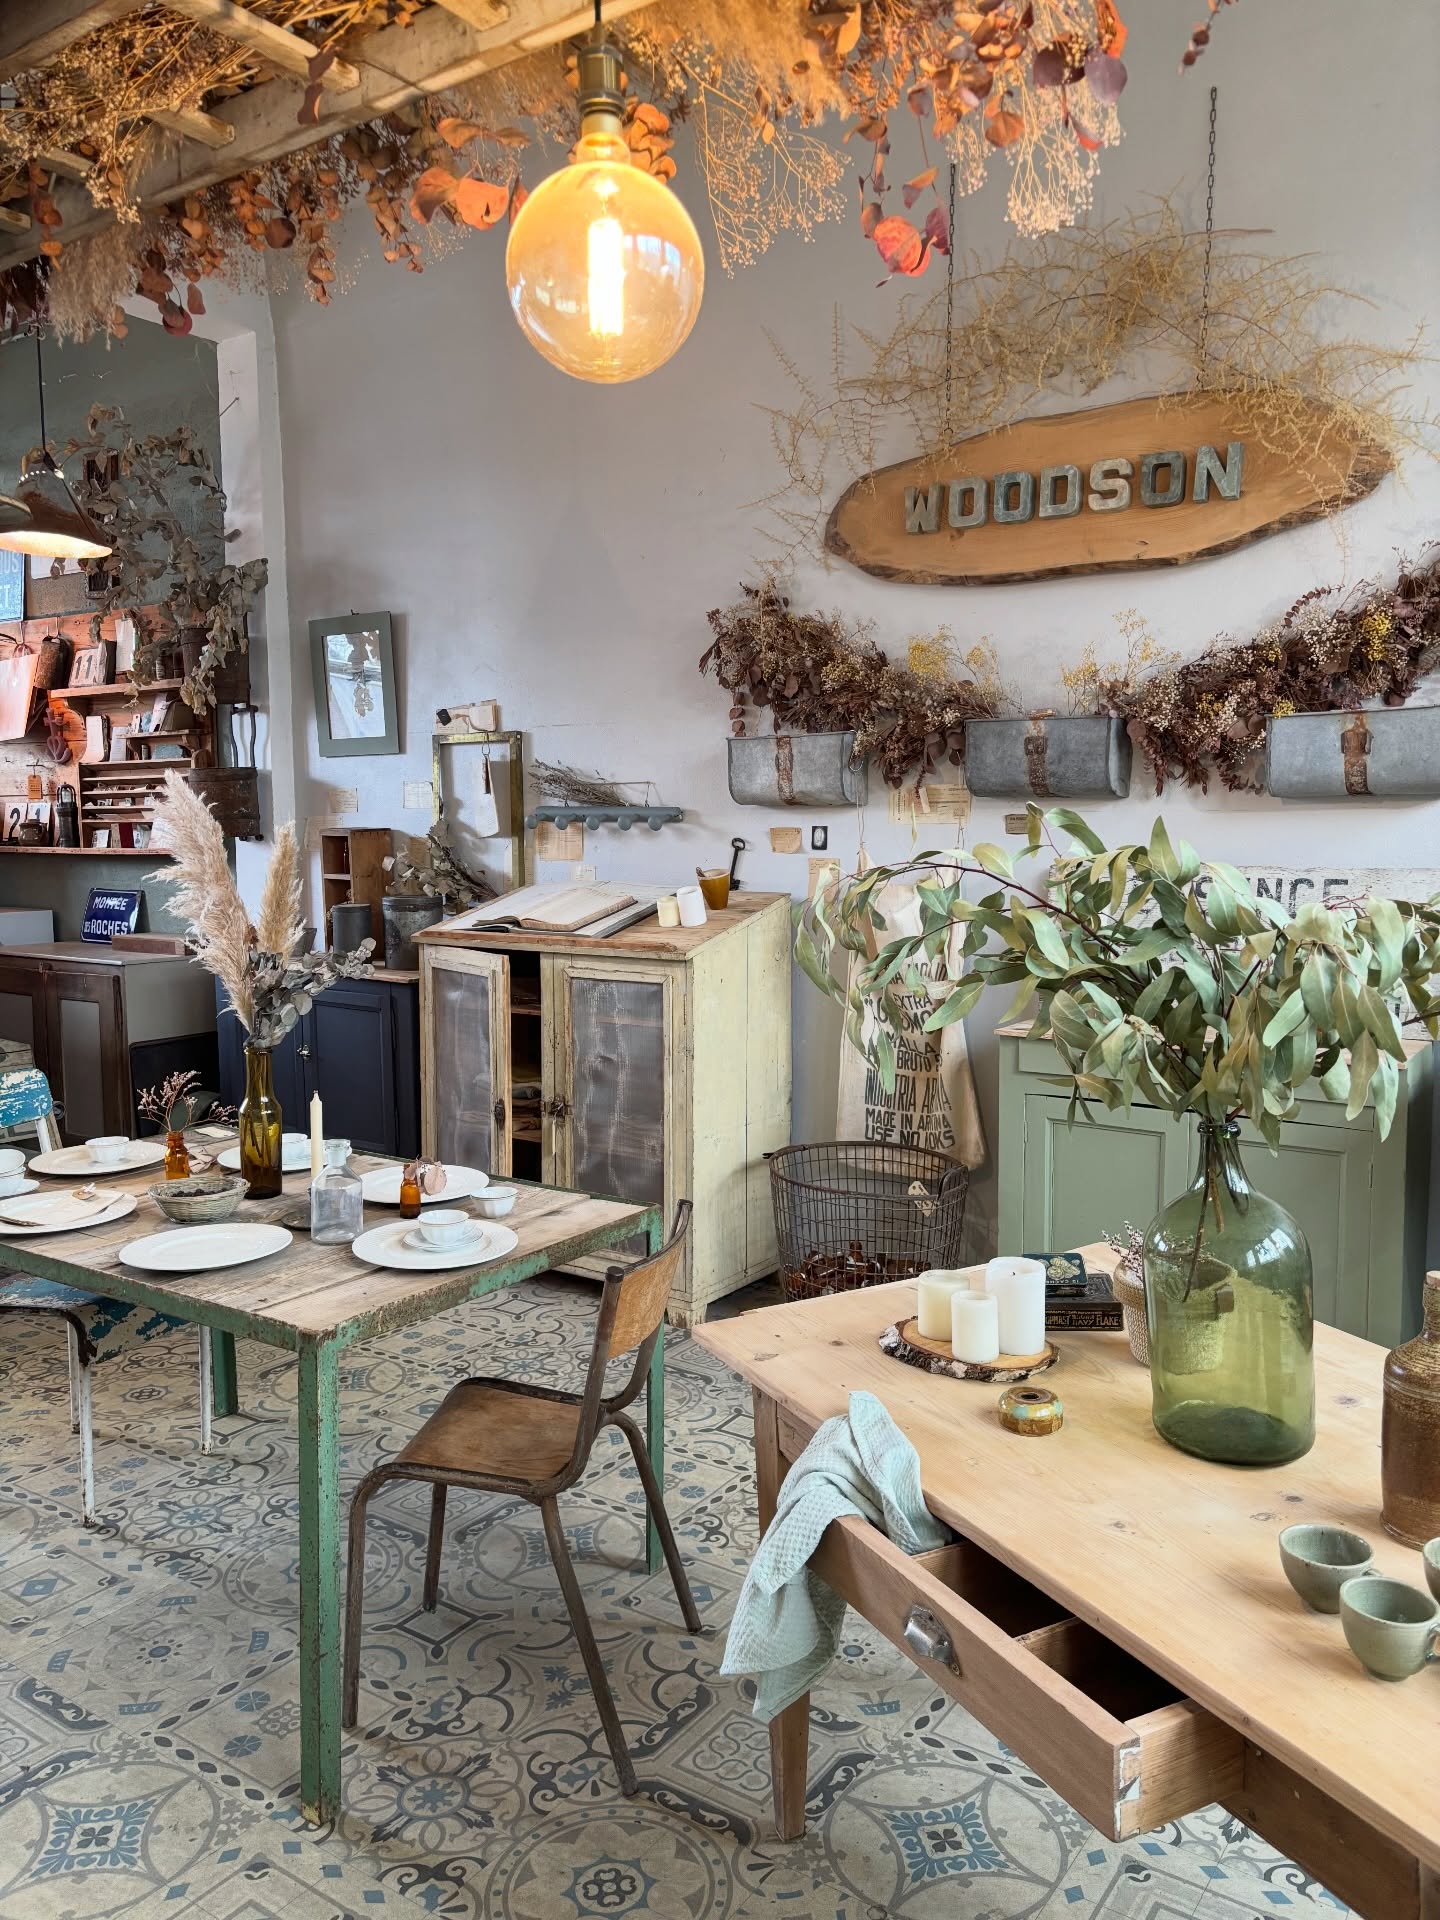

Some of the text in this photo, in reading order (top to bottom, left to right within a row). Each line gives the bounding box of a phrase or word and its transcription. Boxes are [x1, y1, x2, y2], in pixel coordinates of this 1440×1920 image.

[903, 442, 1244, 535] WOODSON
[75, 655, 93, 680] 11
[91, 919, 129, 936] ROCHES
[896, 1049, 931, 1073] BRUTO
[865, 1107, 897, 1129] MADE
[901, 1113, 913, 1131] IN
[865, 1123, 895, 1142] USE
[900, 1129, 920, 1147] NO
[1096, 1314, 1119, 1326] FLAKE
